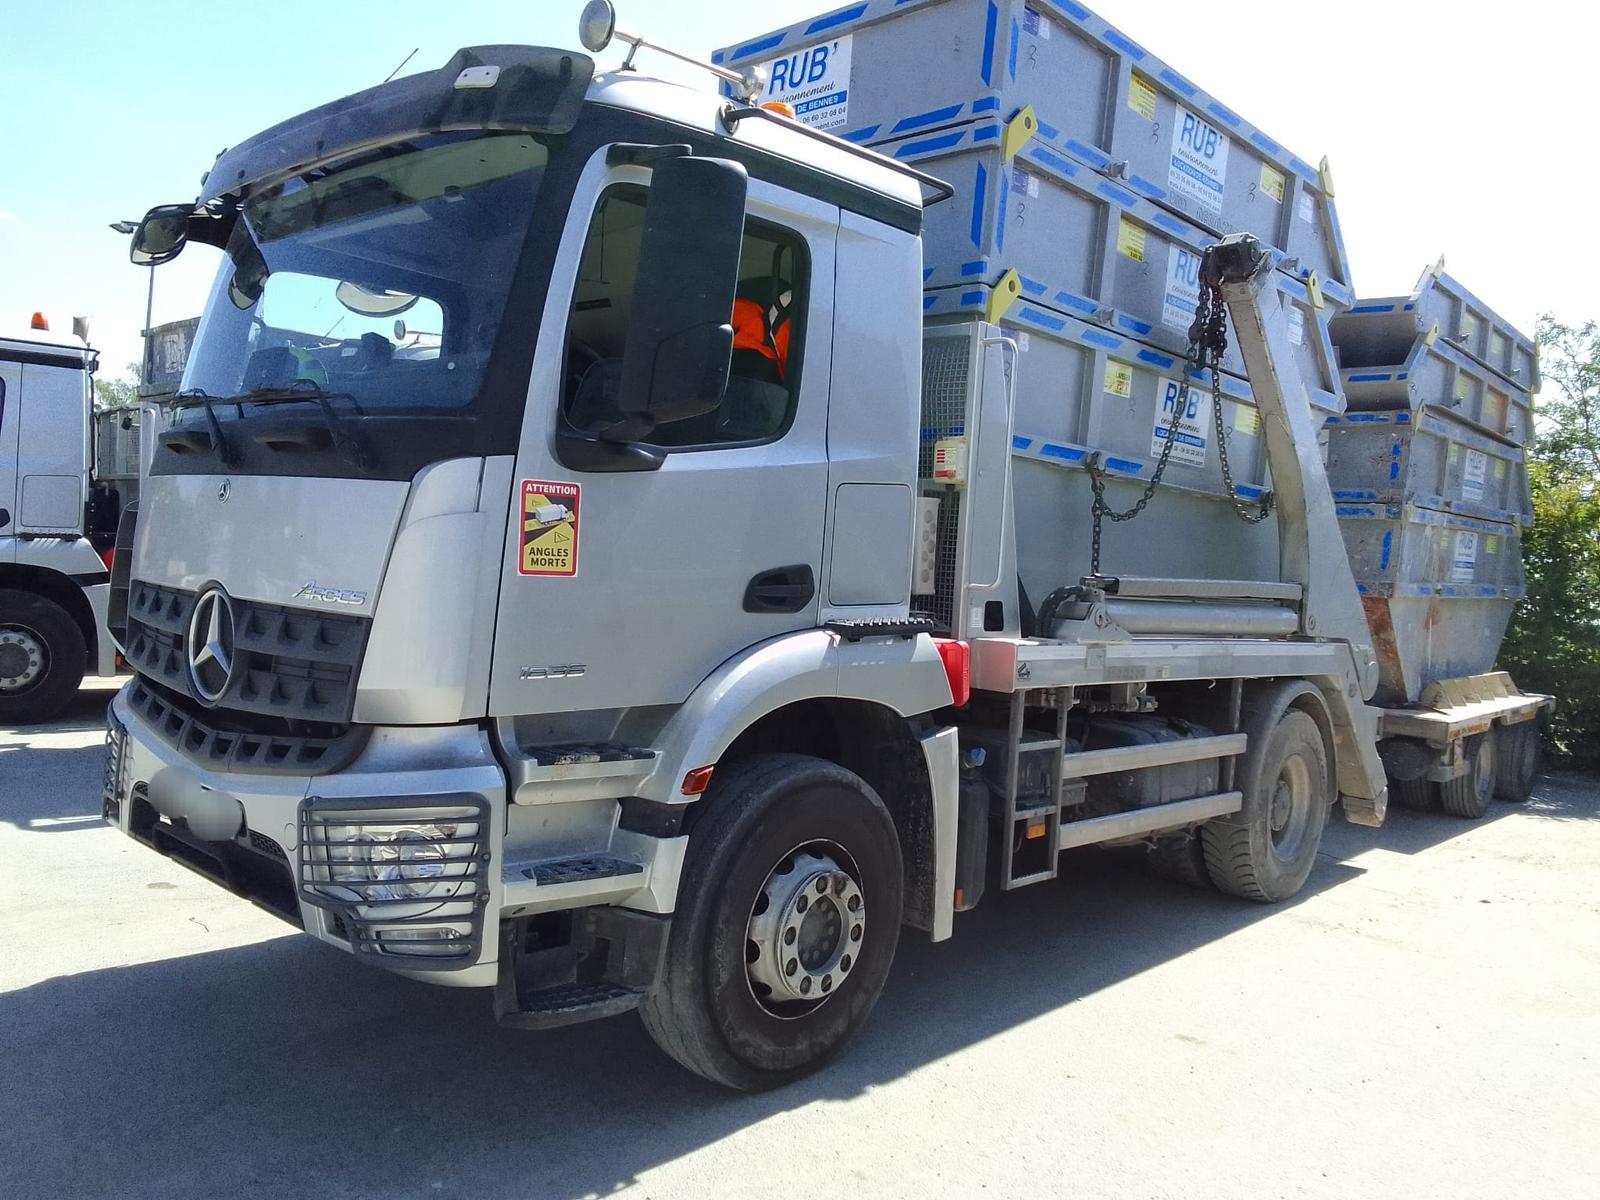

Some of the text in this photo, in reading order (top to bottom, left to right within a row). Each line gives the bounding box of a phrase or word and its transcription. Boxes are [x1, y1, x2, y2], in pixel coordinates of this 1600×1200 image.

[797, 95, 839, 113] DE BENNES
[526, 483, 577, 495] ATTENTION
[528, 546, 569, 557] ANGLES
[530, 557, 567, 568] MORTS
